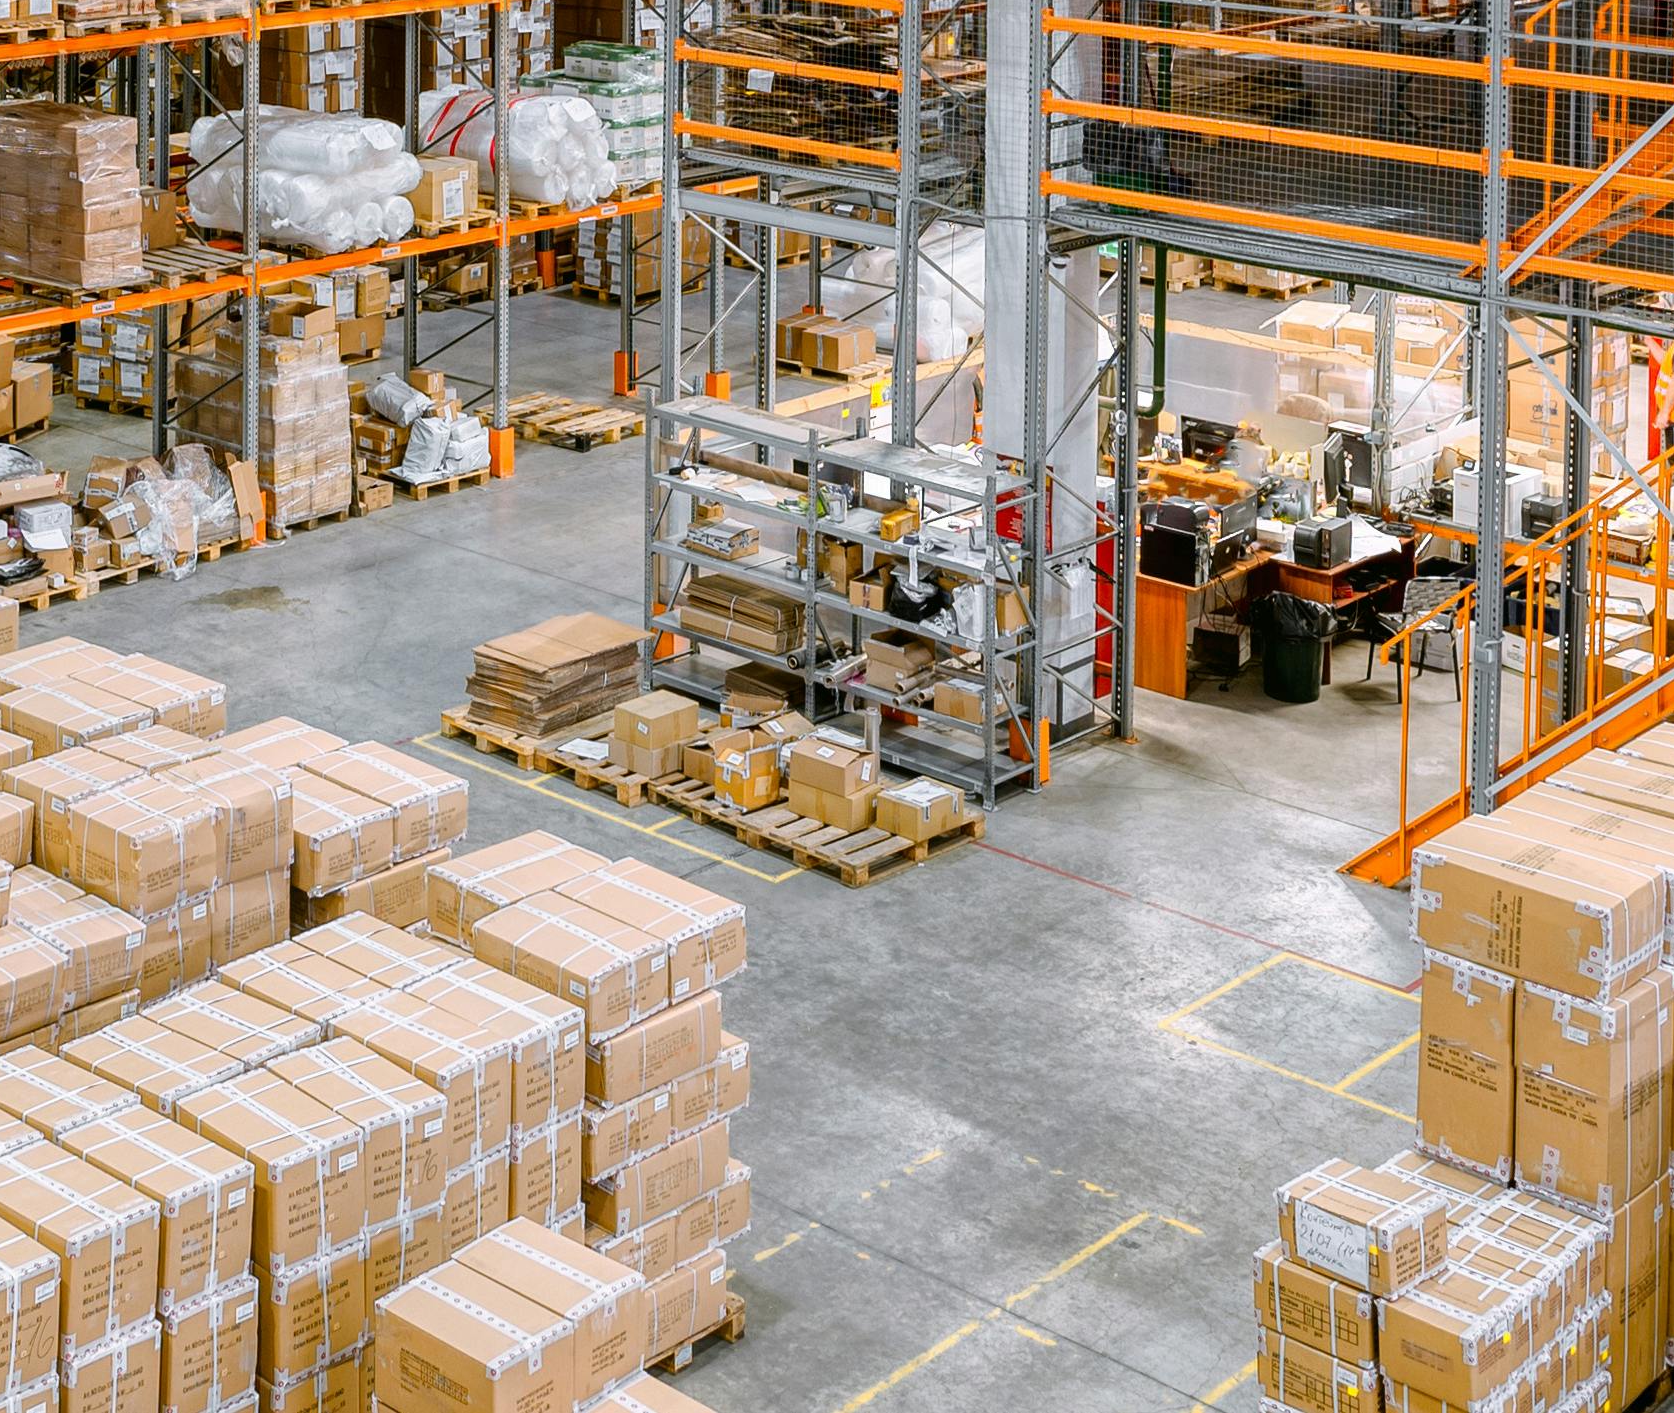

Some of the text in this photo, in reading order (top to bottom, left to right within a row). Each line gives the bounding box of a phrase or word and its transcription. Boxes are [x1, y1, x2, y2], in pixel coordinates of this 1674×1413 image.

[1428, 1061, 1442, 1071] MADE
[1451, 1070, 1468, 1082] CHINA
[1479, 1081, 1498, 1092] RUSSIA
[1525, 1097, 1540, 1107] MADE
[1549, 1106, 1567, 1117] CHINA
